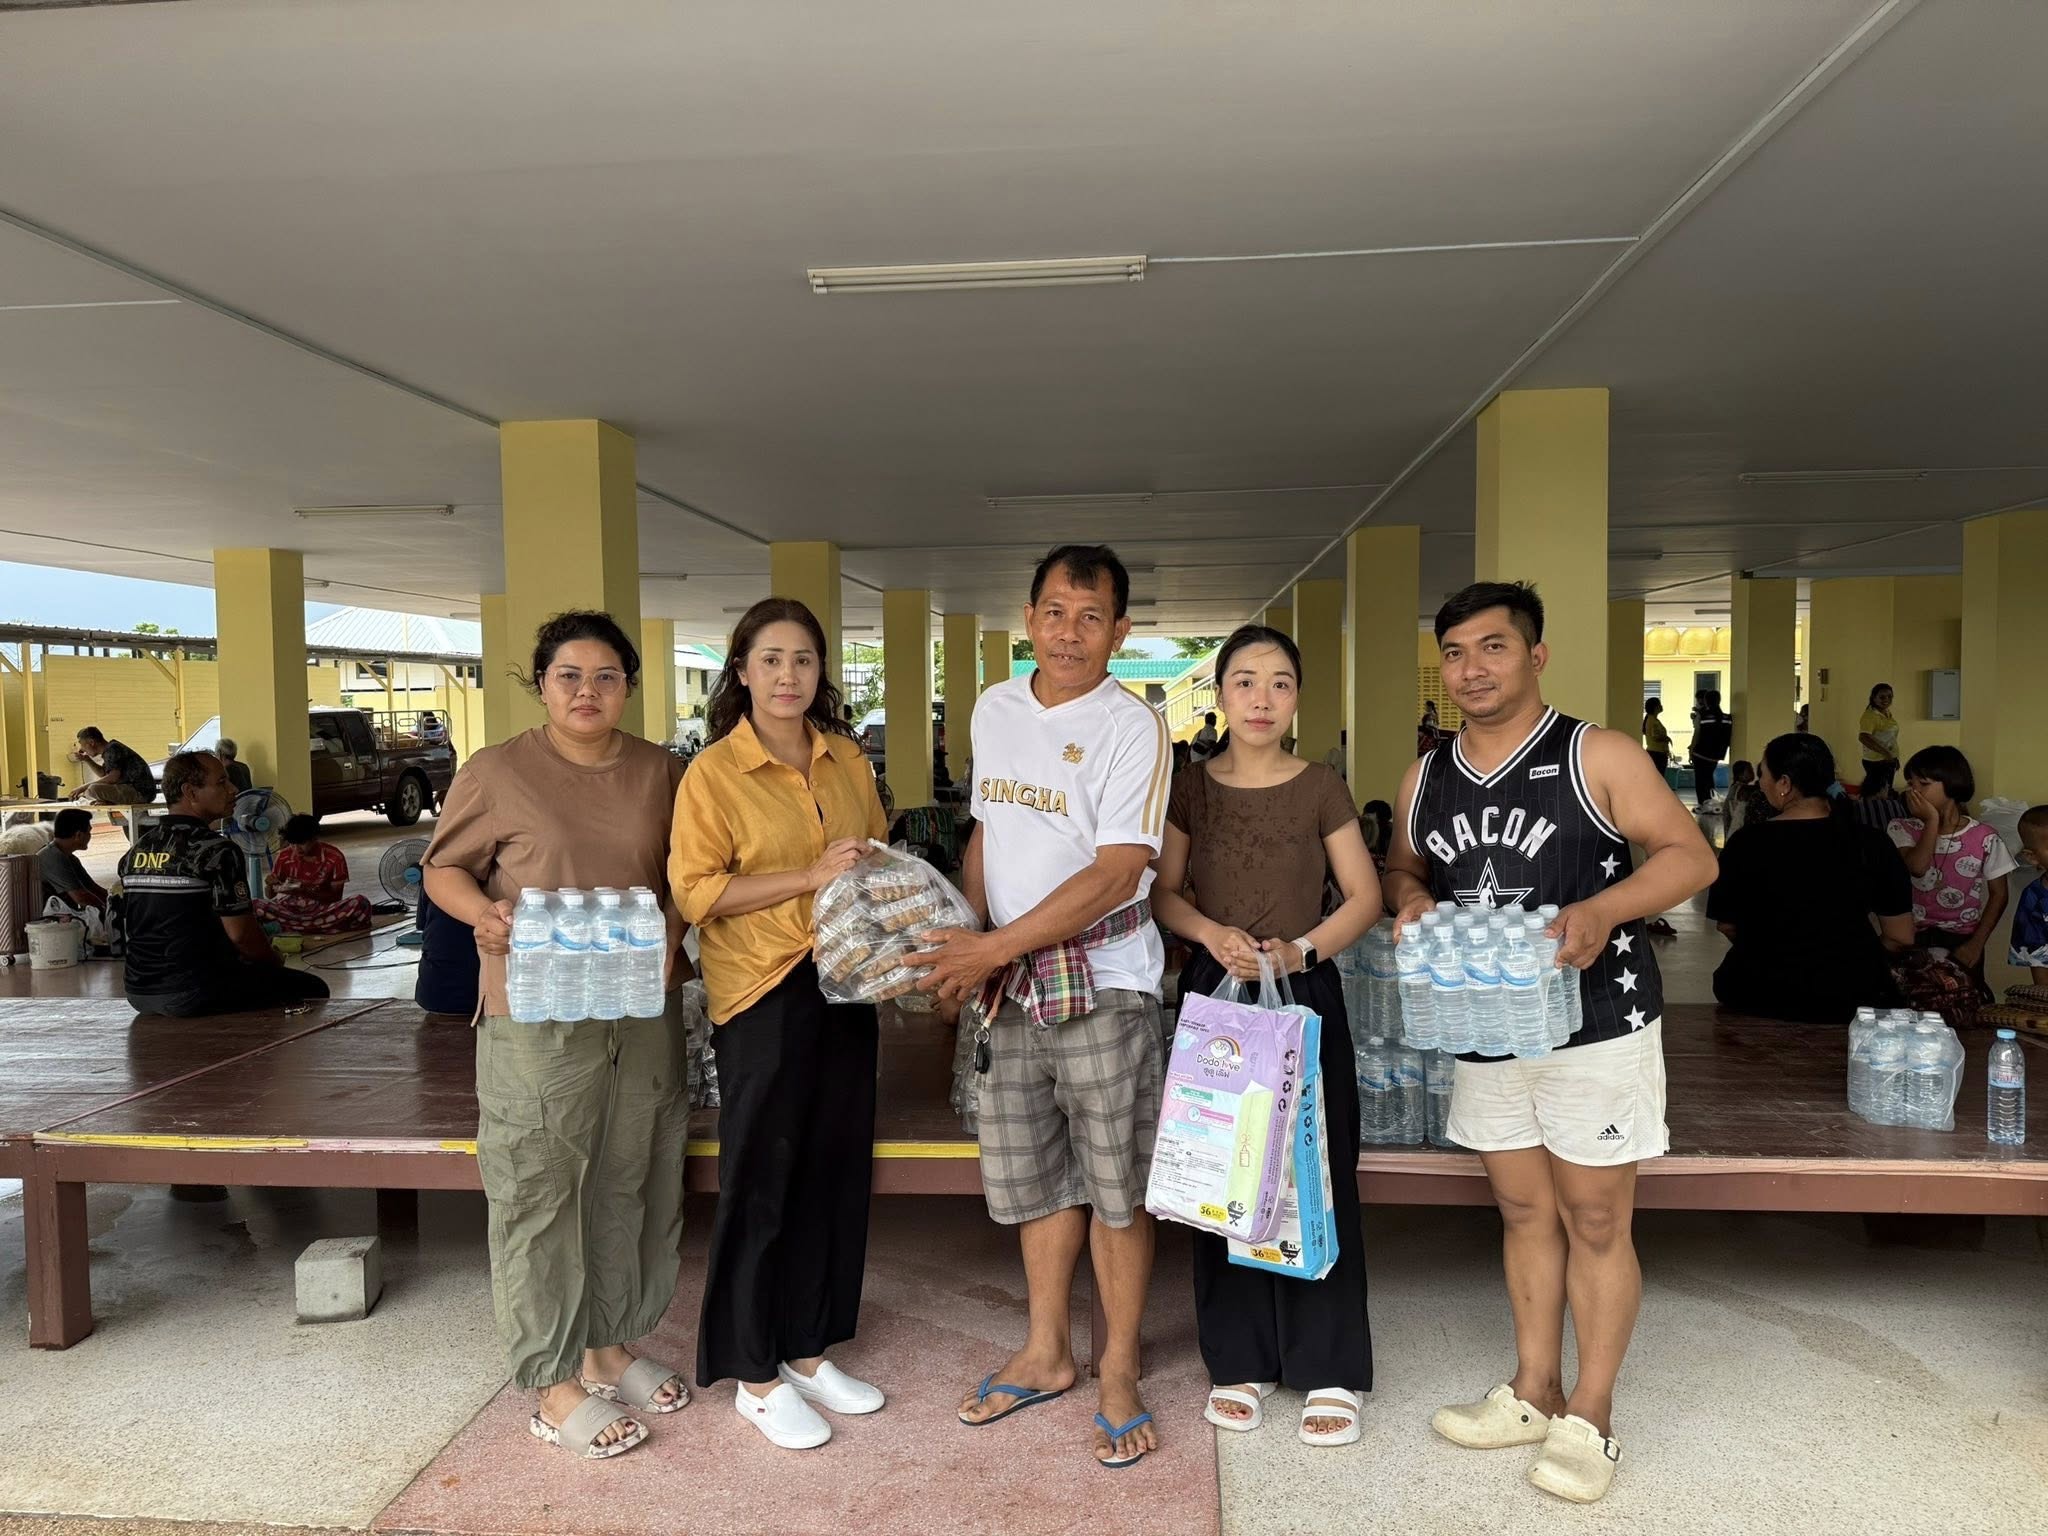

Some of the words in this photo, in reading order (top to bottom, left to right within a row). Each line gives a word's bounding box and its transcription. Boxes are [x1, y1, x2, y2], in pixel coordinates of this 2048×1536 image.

[1531, 767, 1557, 777] Bacon
[980, 778, 1069, 817] SINGHA
[1425, 806, 1558, 866] BACON
[133, 852, 170, 869] DNP
[1197, 1054, 1219, 1066] Dodo
[1200, 1206, 1211, 1216] 56
[1237, 1202, 1244, 1210] S
[1252, 1248, 1264, 1258] 36
